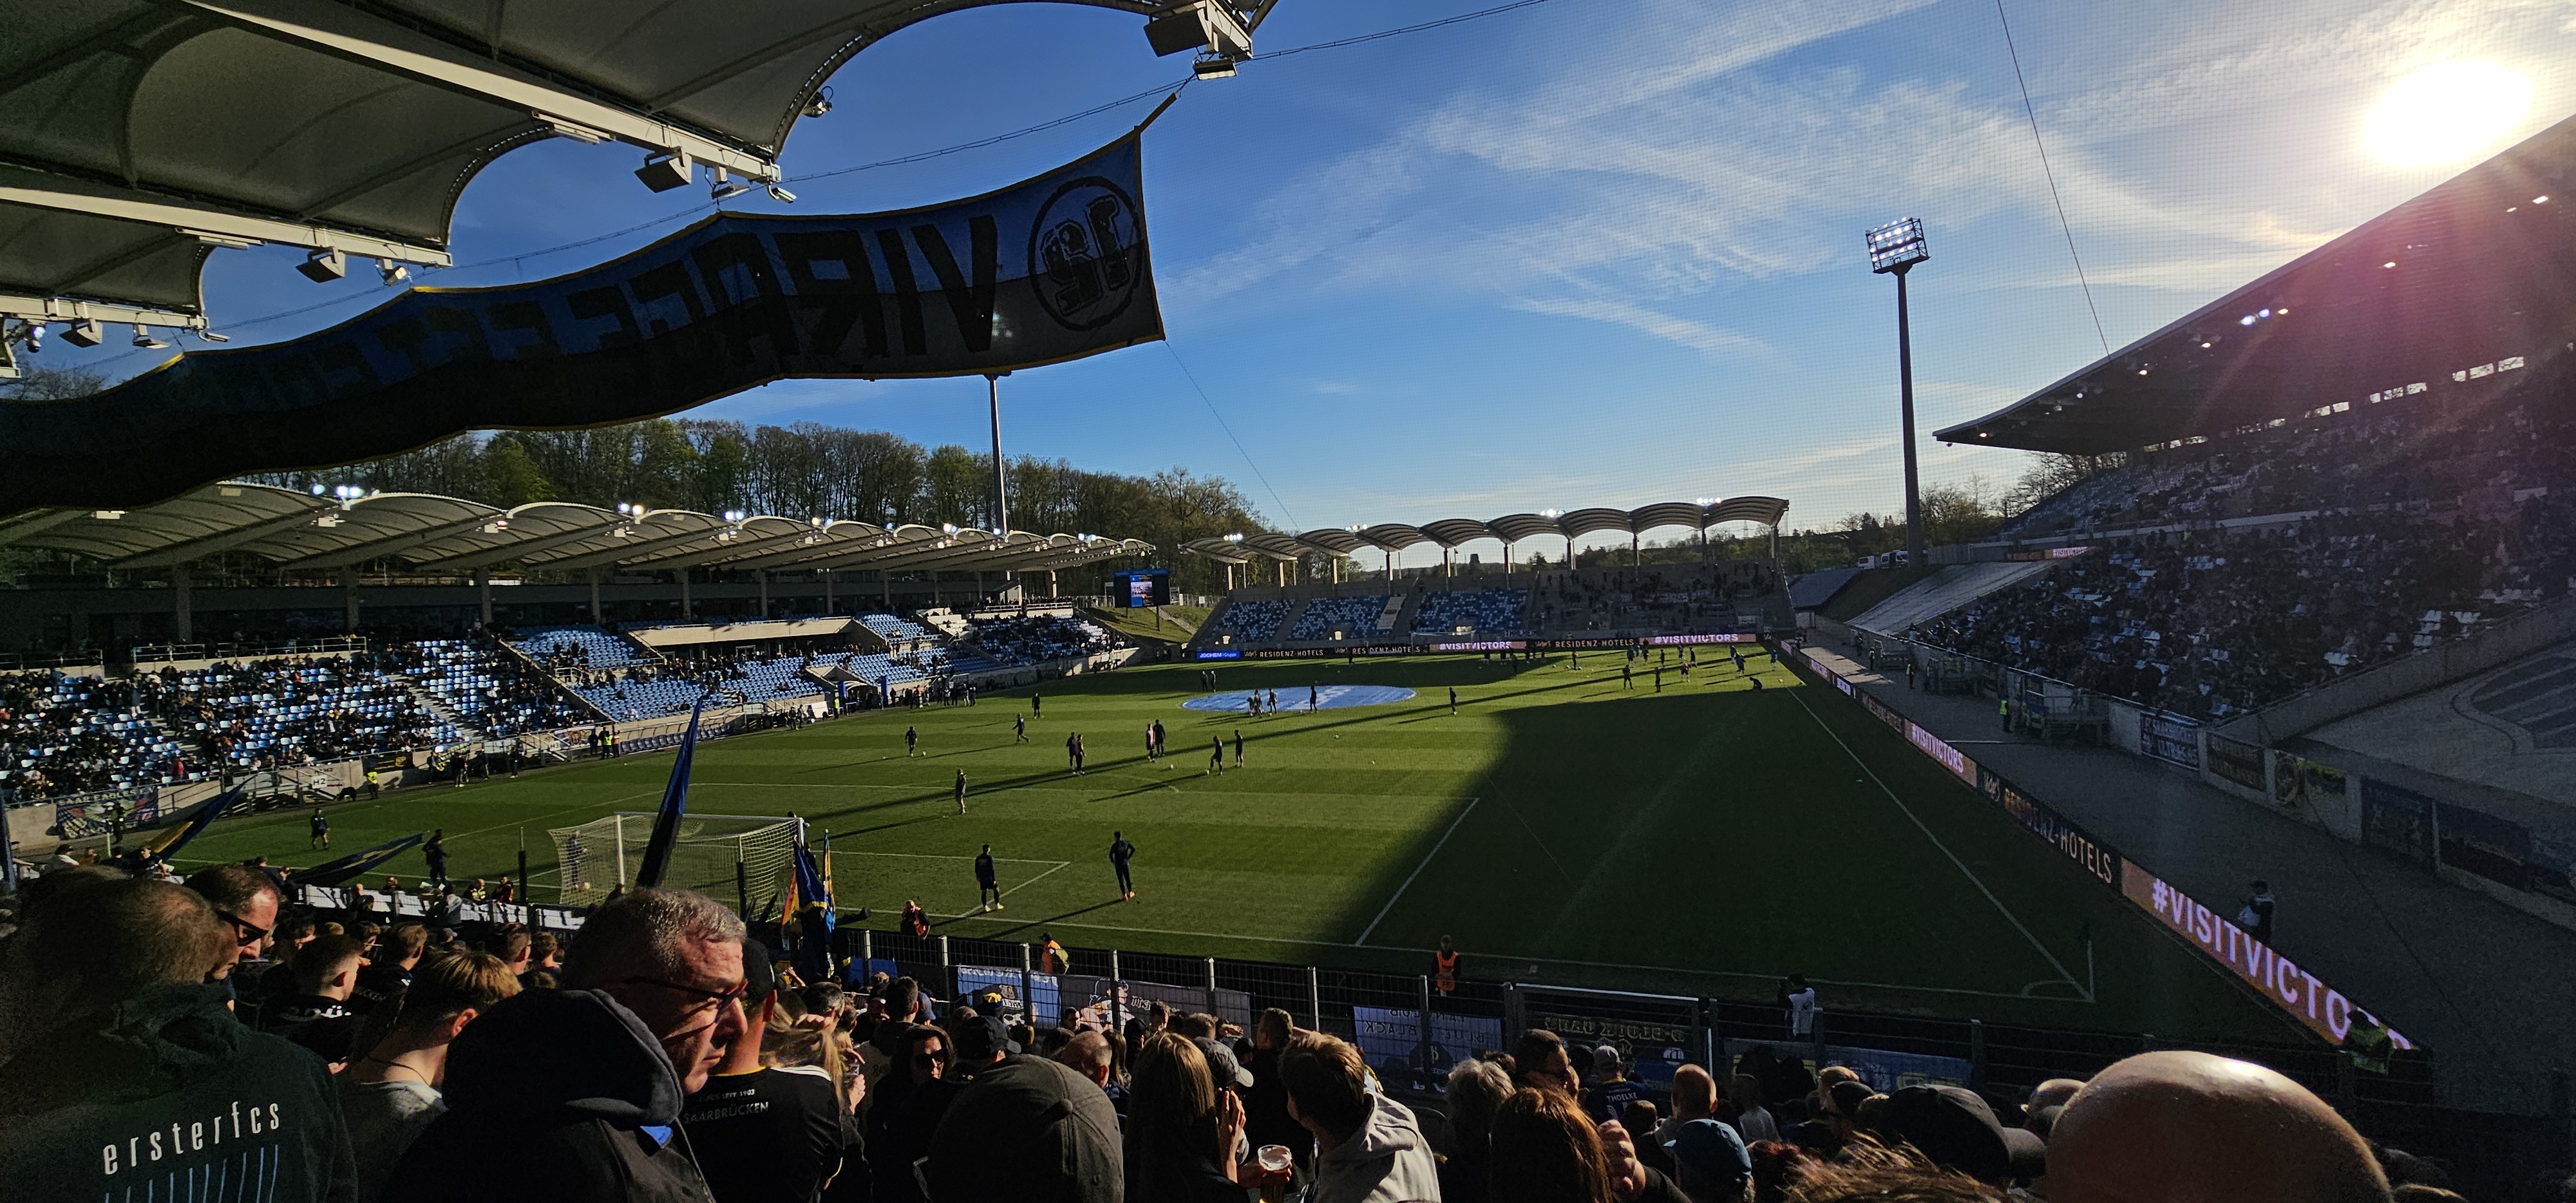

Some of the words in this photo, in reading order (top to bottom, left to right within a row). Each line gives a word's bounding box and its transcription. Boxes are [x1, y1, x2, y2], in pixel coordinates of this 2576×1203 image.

[1555, 638, 1634, 648] RESIDENZ-HOTELS
[1654, 633, 1739, 644] #VISITVICTORS
[1352, 646, 1421, 654] RESDENZ-HOTES
[1439, 641, 1513, 650] #VISITVICTORS
[2152, 876, 2410, 1050] #VISITVICTO
[739, 1088, 755, 1097] 1903
[1605, 1091, 1638, 1103] THOELKE
[683, 1101, 769, 1124] SAARBRÜCKEN
[103, 1101, 279, 1175] ersterfcs
